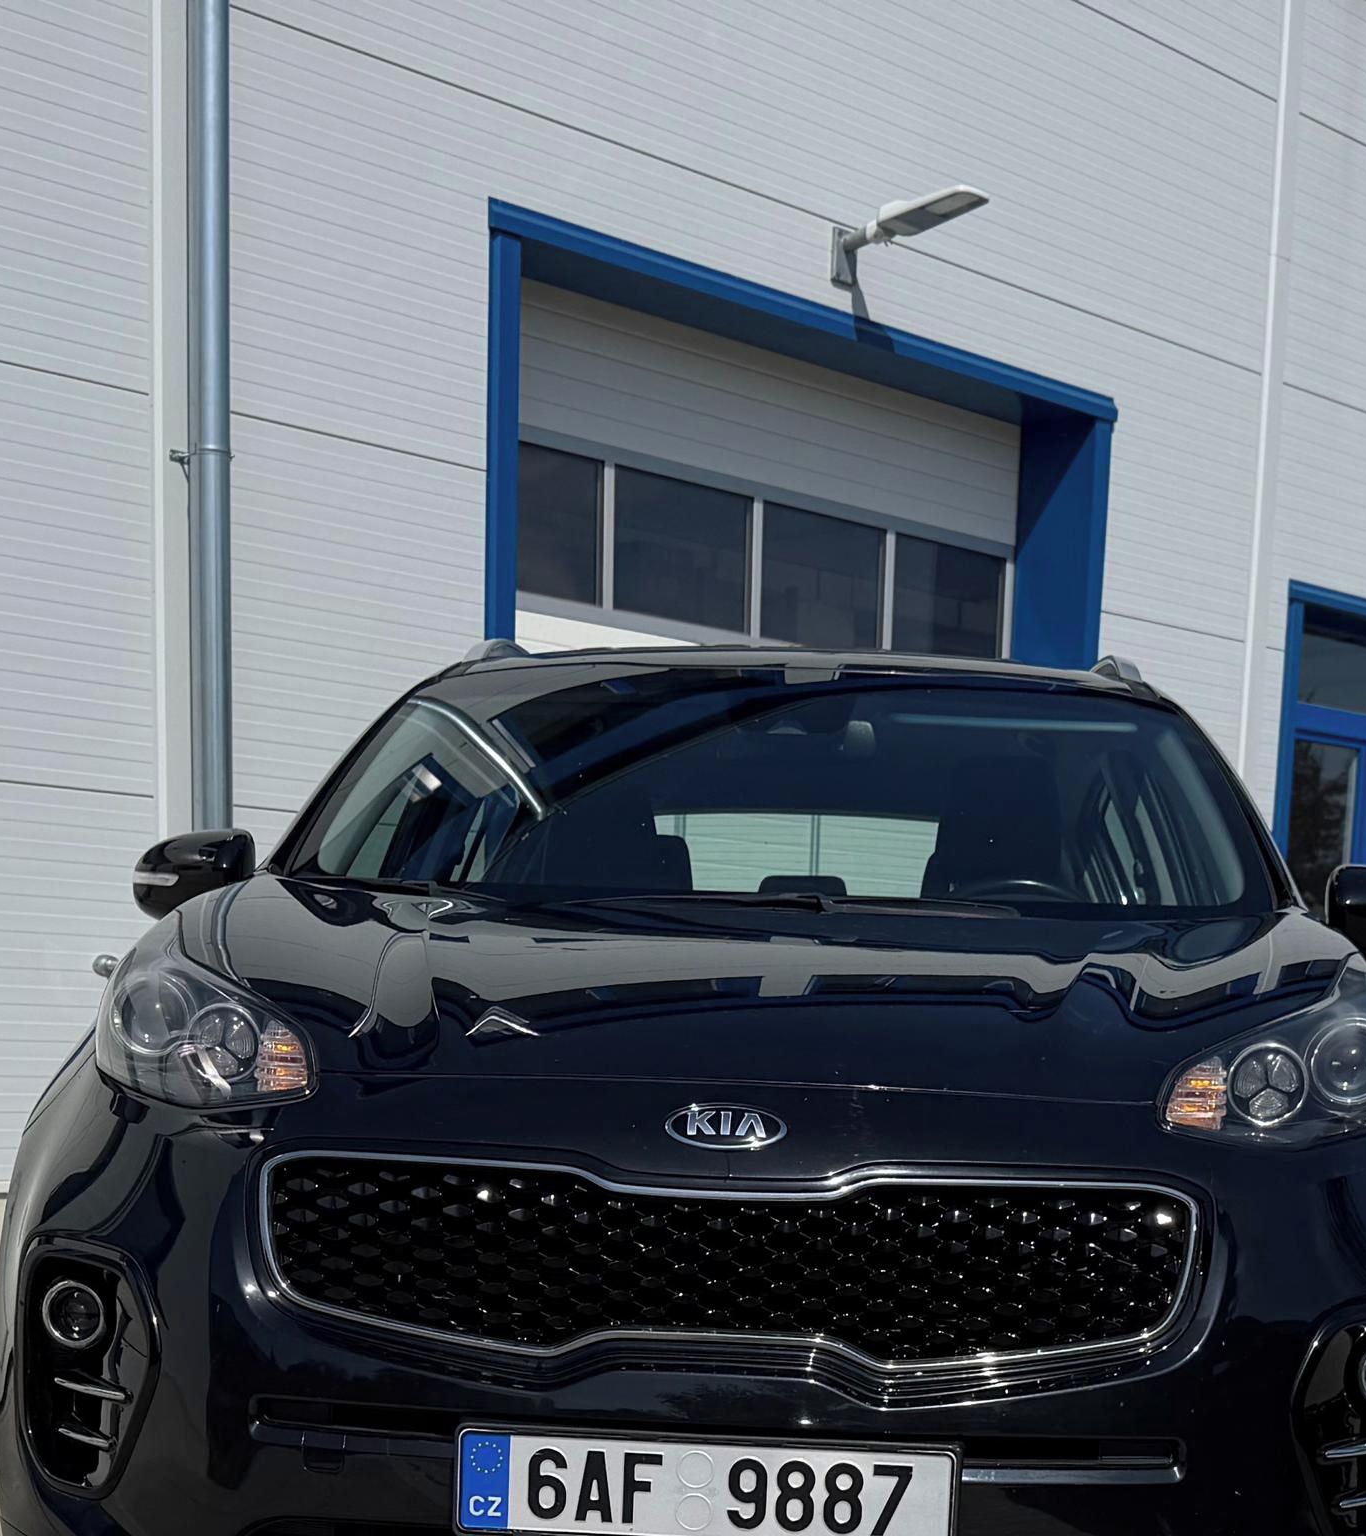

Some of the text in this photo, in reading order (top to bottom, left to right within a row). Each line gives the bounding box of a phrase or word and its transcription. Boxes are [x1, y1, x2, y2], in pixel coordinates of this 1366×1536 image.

[686, 1110, 767, 1138] KIA
[469, 1495, 502, 1517] CZ
[526, 1448, 914, 1536] 6AF 9887
